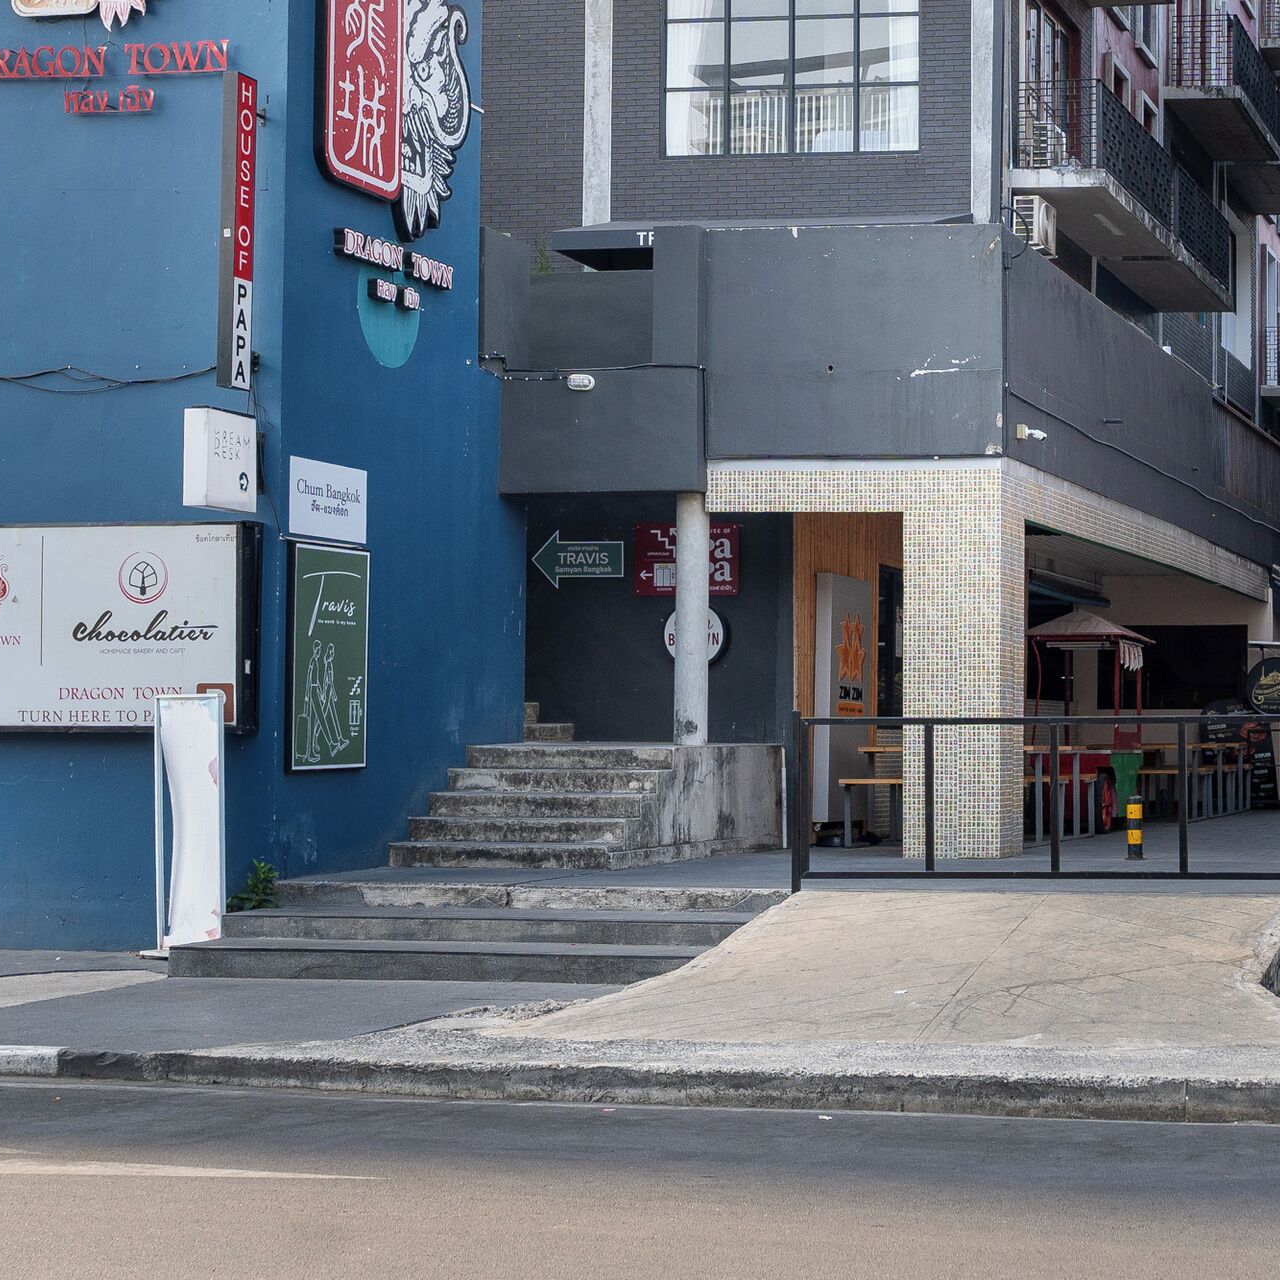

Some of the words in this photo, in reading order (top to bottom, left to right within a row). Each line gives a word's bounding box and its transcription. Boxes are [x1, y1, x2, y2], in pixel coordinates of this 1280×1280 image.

[123, 39, 230, 75] TOWN
[239, 82, 253, 209] HOUSE
[238, 224, 251, 271] OF
[344, 228, 404, 271] DRAGON
[411, 252, 454, 290] TOWN
[234, 283, 248, 384] PAPA
[296, 478, 324, 498] Chum
[326, 483, 361, 506] Bangkok
[554, 566, 582, 574] Samyan
[583, 565, 613, 575] Bangkok
[557, 552, 609, 565] TRAVIS
[58, 686, 125, 700] DRAGON
[18, 710, 64, 723] TURN
[68, 710, 112, 723] HERE
[115, 710, 138, 723] TO
